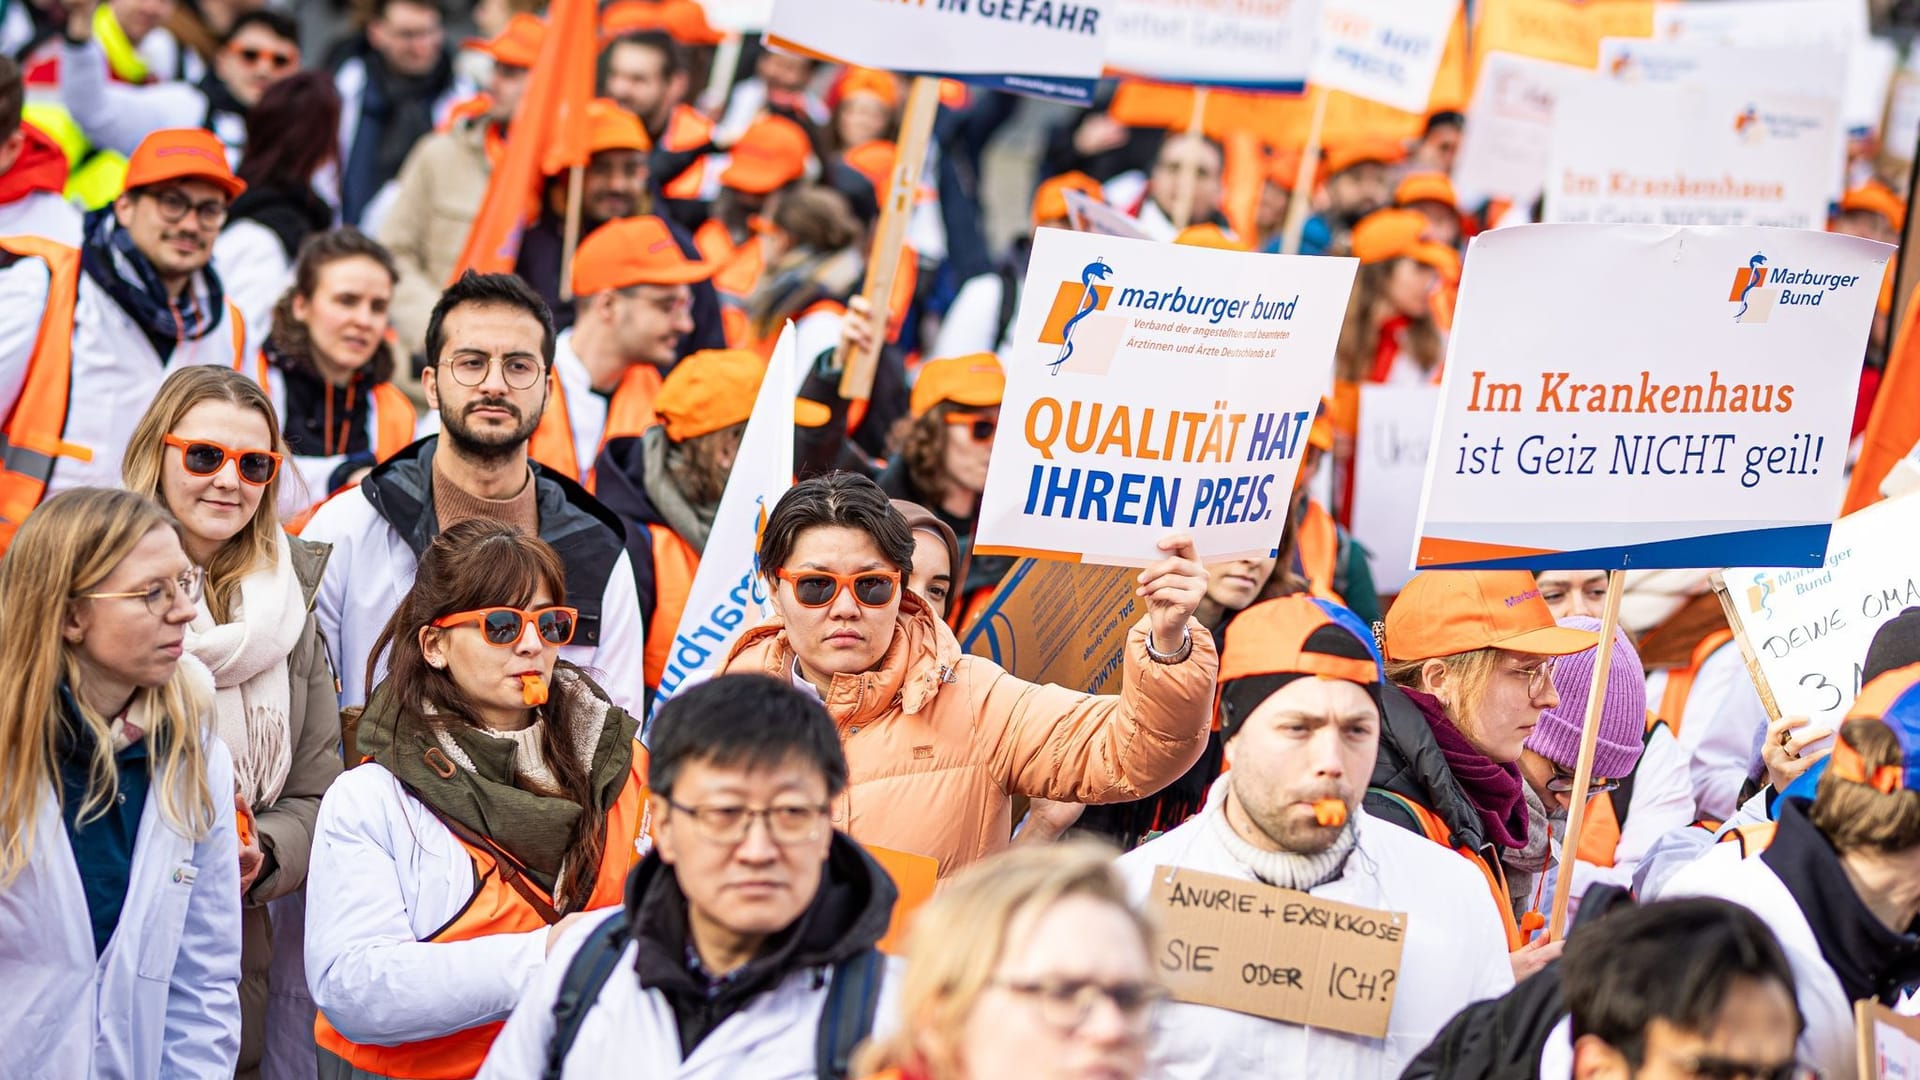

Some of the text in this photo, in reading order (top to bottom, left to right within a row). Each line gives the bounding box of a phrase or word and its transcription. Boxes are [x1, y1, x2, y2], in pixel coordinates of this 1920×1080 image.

[976, 0, 1101, 36] GEFAHR
[1769, 267, 1860, 290] Marburger
[1118, 286, 1299, 324] marburger bund
[1779, 290, 1824, 307] Bund
[1126, 336, 1173, 352] Ärztinnen
[1176, 343, 1195, 354] und
[1195, 343, 1220, 357] Ärzte
[1220, 346, 1265, 359] Deutschlands
[1133, 318, 1290, 340] Verband der angestellten und beamteten
[1466, 371, 1795, 413] Im Krankenhaus
[1023, 396, 1247, 463] QUALITÄT
[1247, 411, 1310, 462] HAT
[1456, 433, 1504, 475] ist
[1517, 433, 1597, 475] Geiz
[1609, 434, 1736, 475] NICHT
[1740, 433, 1825, 488] geil!
[1023, 464, 1275, 528] IHREN PREIS.
[1795, 569, 1832, 596] Bund
[1118, 598, 1135, 621] BAL
[1762, 608, 1847, 659] DEINE
[1167, 881, 1403, 942] ANURIE + EXSIKKOSE
[1160, 938, 1396, 1002] SIE ODER ICH?
